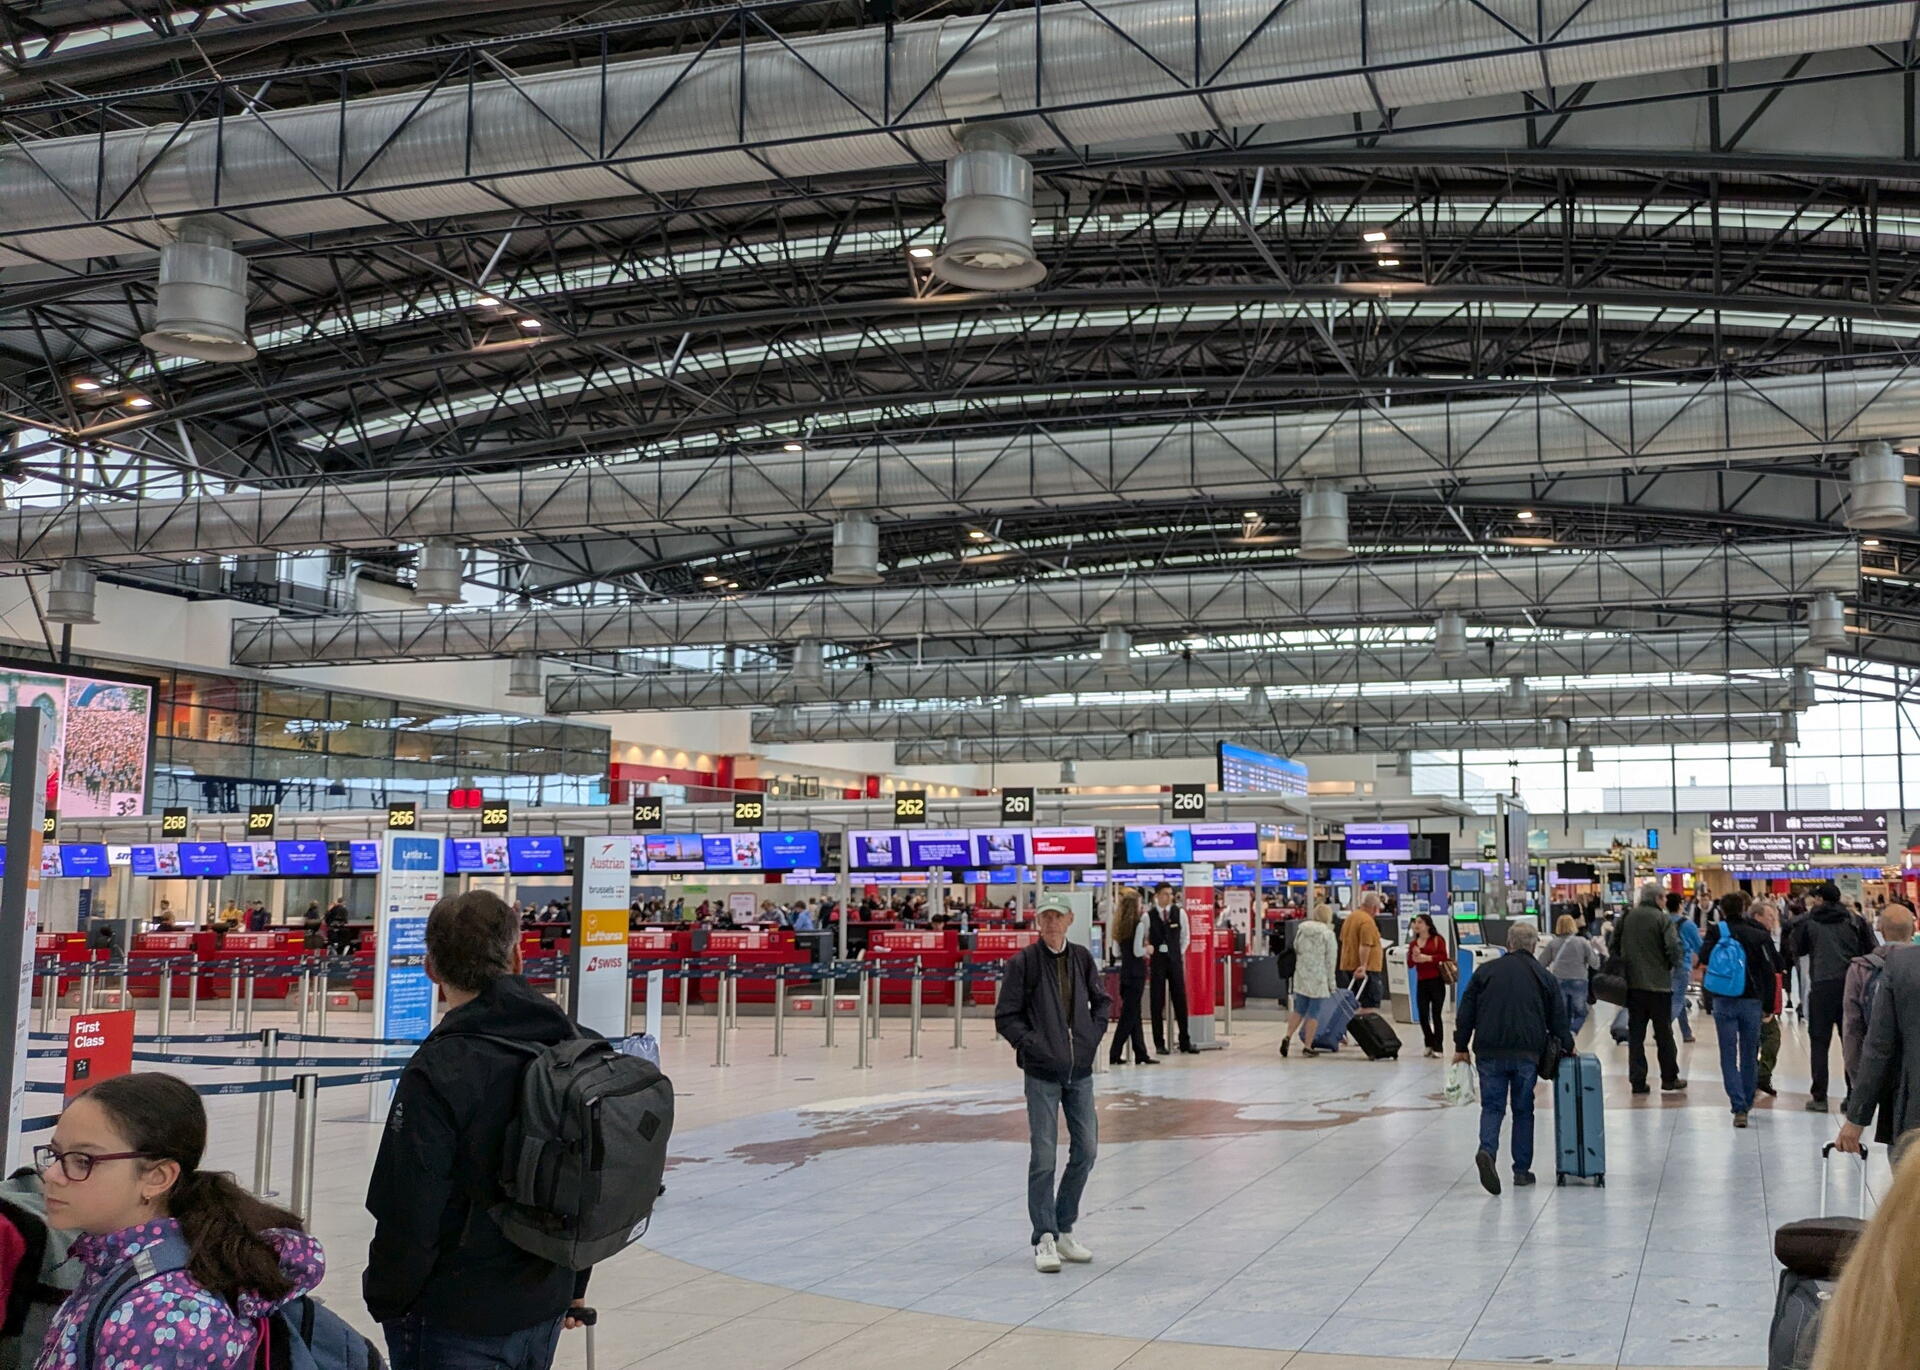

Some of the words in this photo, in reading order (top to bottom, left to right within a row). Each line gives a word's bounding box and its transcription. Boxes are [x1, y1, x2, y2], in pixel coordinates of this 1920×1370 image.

[896, 799, 924, 815] 262
[1005, 796, 1030, 813] 261
[1174, 793, 1204, 810] 260
[483, 809, 508, 824] 265
[634, 806, 661, 821] 264
[735, 803, 762, 819] 263
[43, 818, 55, 832] 69
[163, 816, 187, 830] 268
[250, 814, 273, 828] 267
[389, 811, 414, 826] 266
[591, 857, 624, 869] Austrian
[589, 886, 614, 894] brussels
[587, 931, 623, 942] Lufthansa
[597, 957, 622, 969] SWISS
[75, 1020, 100, 1034] First
[74, 1035, 105, 1049] Class
